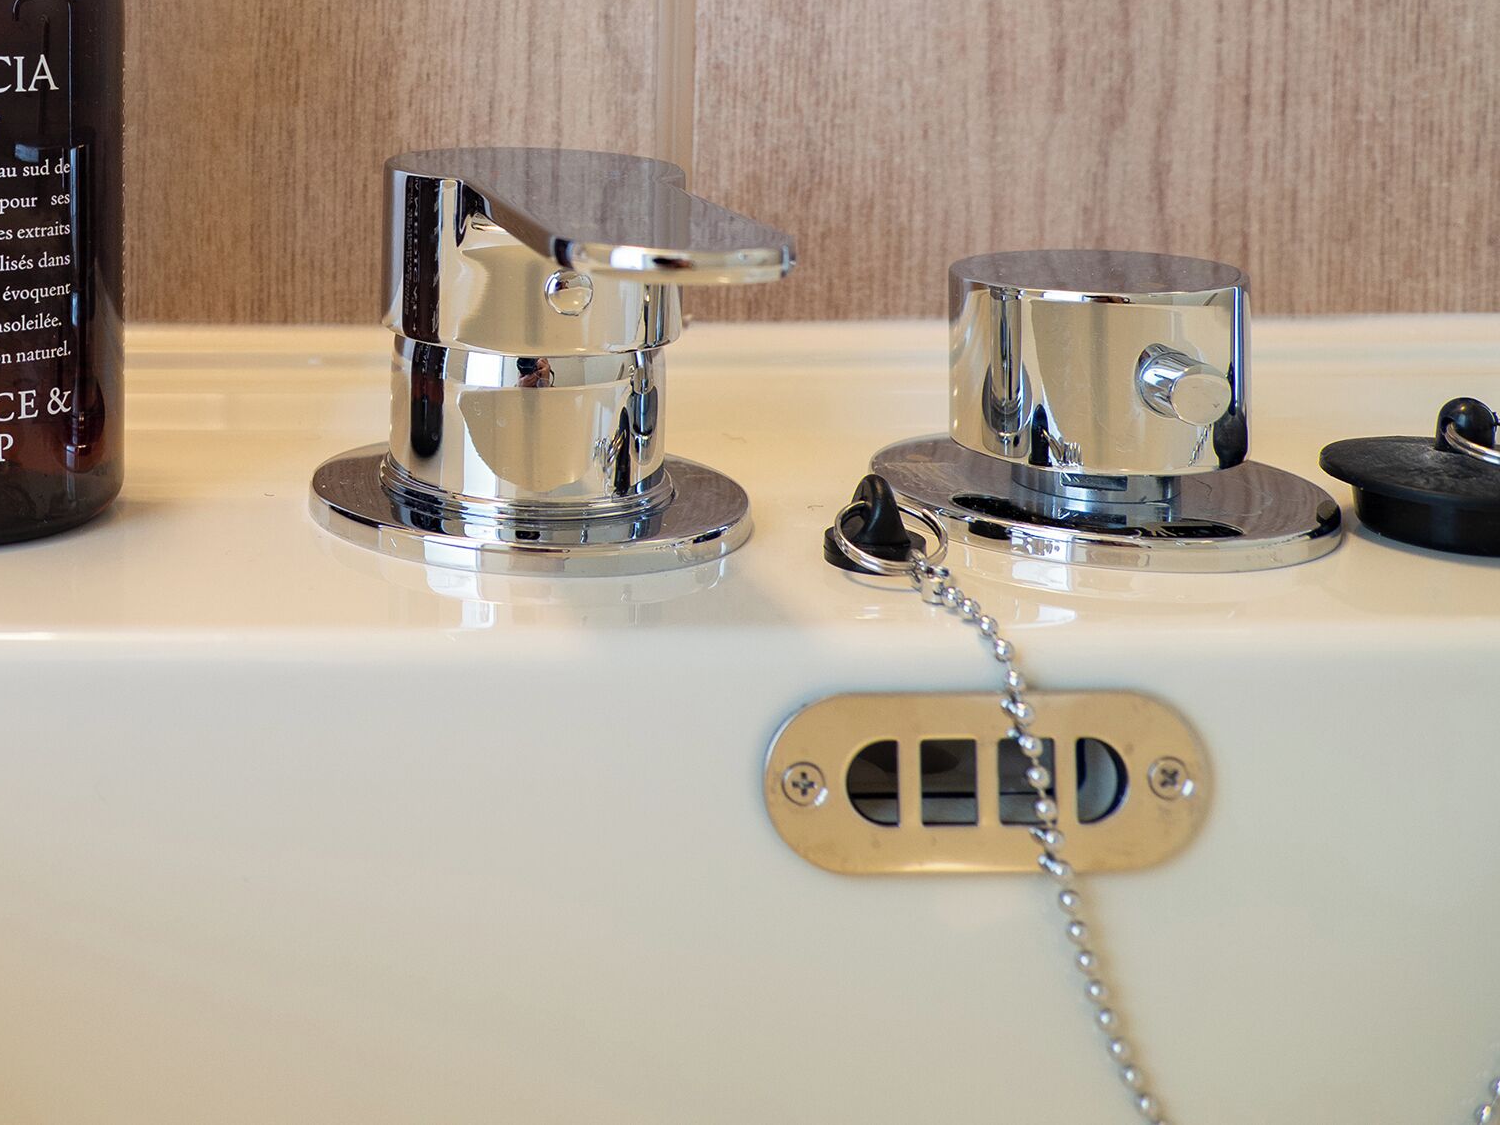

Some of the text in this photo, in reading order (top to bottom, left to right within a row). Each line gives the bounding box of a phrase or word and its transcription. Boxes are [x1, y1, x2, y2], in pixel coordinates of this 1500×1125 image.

[22, 159, 51, 178] sud
[54, 157, 71, 175] de
[50, 193, 71, 206] ses
[16, 222, 71, 240] extraits
[37, 252, 71, 270] dans
[2, 282, 71, 305] évoquent
[15, 340, 72, 364] naturel.
